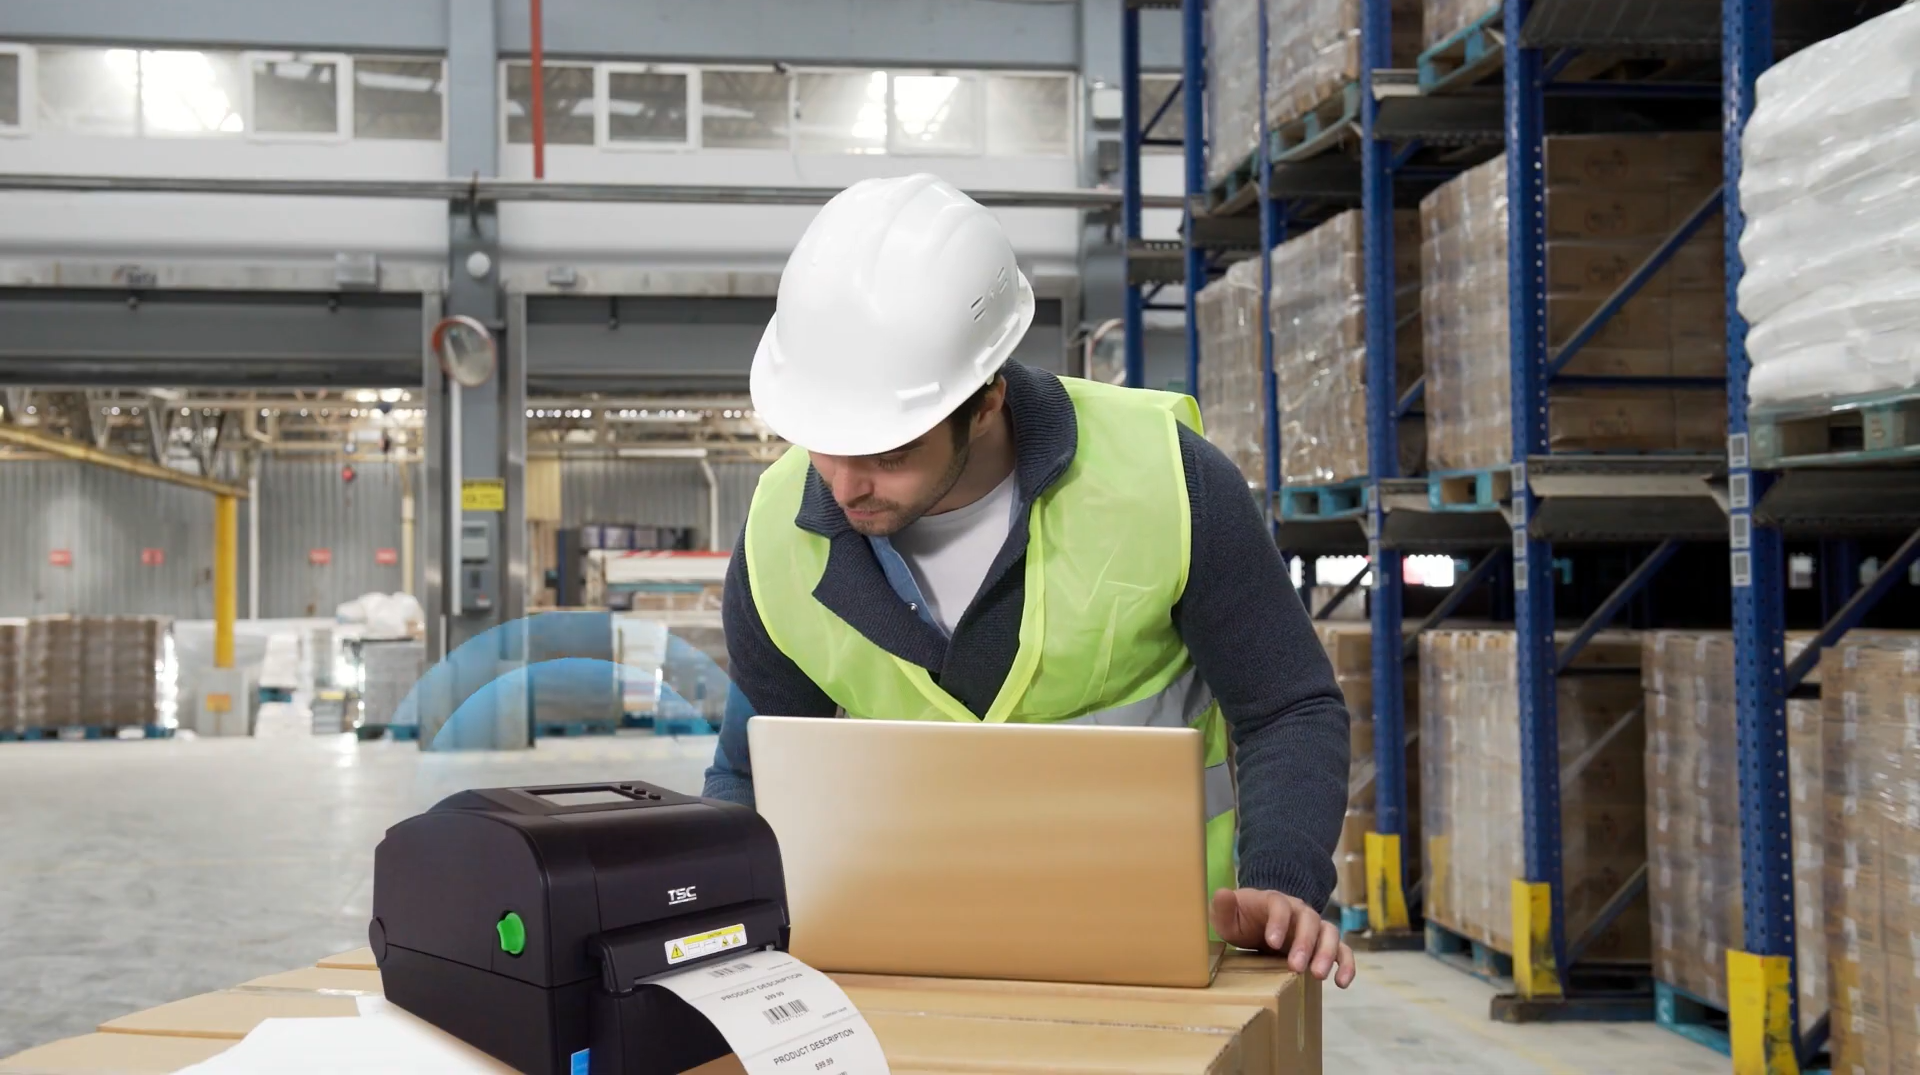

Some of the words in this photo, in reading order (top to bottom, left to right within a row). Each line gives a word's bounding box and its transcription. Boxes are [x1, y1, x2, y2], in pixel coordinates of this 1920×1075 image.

[667, 886, 697, 902] TSC
[773, 1045, 810, 1066] PRODUCT
[809, 1027, 855, 1052] DESCRIPTION
[814, 1057, 834, 1071] $99.99
